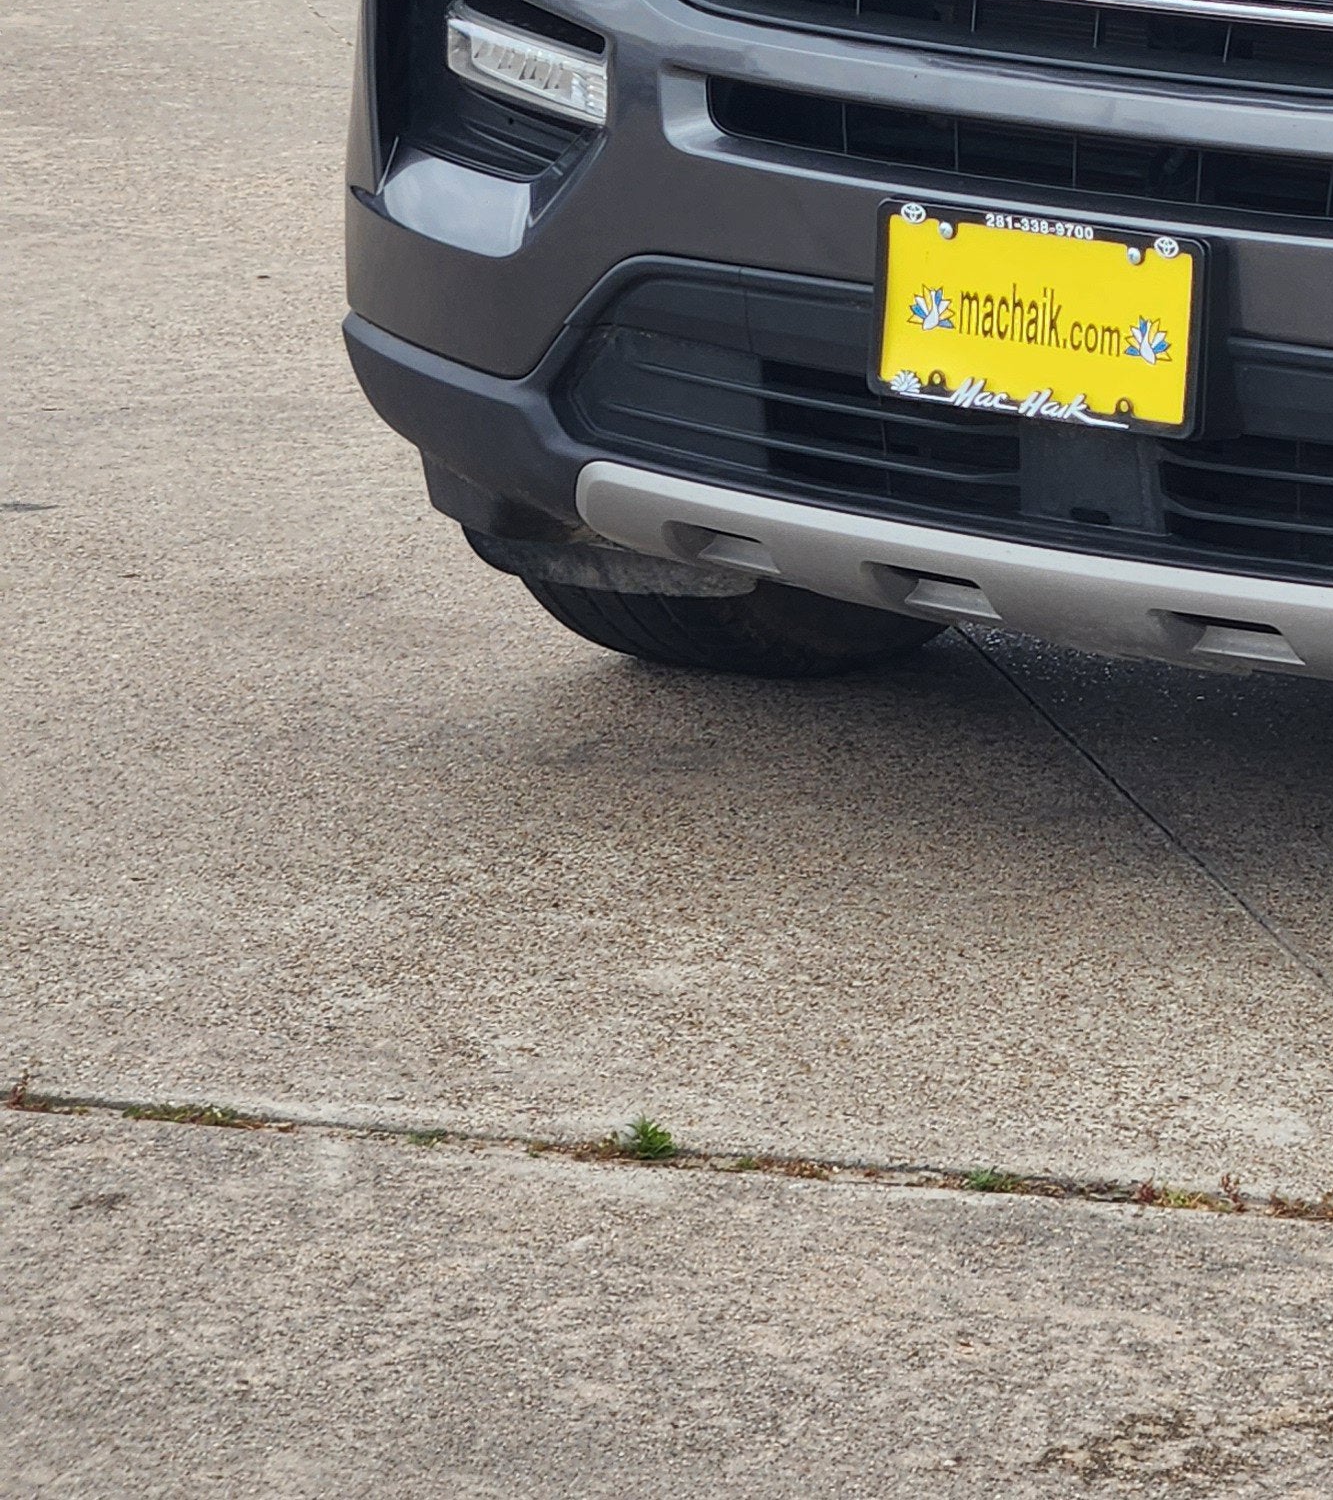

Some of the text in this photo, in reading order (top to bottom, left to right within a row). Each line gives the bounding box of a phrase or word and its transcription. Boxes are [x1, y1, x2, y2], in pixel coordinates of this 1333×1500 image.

[985, 212, 1094, 240] 281-338-9700
[958, 283, 1121, 357] machaik.com
[949, 376, 1110, 426] Mac Haik
